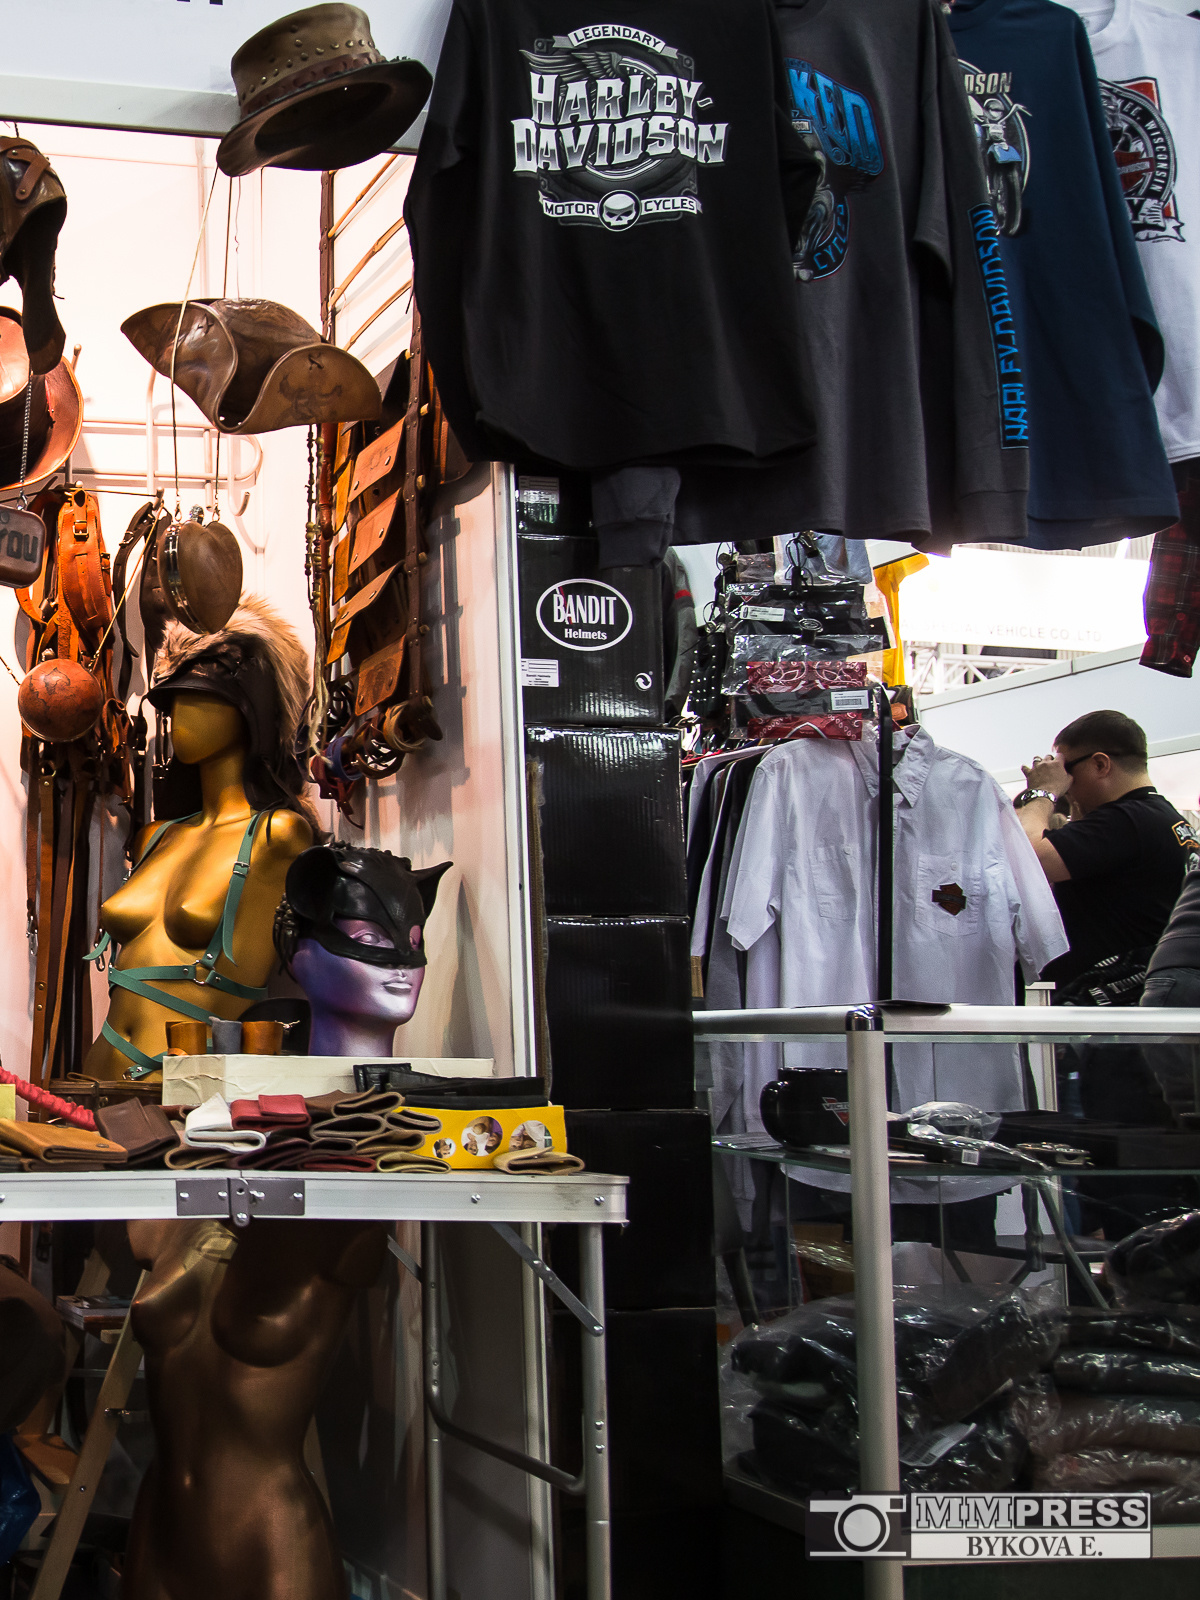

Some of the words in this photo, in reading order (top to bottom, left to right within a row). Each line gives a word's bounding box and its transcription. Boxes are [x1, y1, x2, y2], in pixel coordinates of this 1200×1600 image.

[573, 25, 662, 49] LEGENDARY
[530, 71, 713, 126] HARLEY-
[511, 115, 729, 173] DAVIDSON
[1144, 119, 1169, 192] WISCONSIN
[545, 202, 596, 216] MOTOR
[644, 199, 695, 213] CYCLES
[553, 590, 617, 625] BANDIT
[564, 628, 608, 640] Helmets
[987, 624, 1046, 639] VEHICLE
